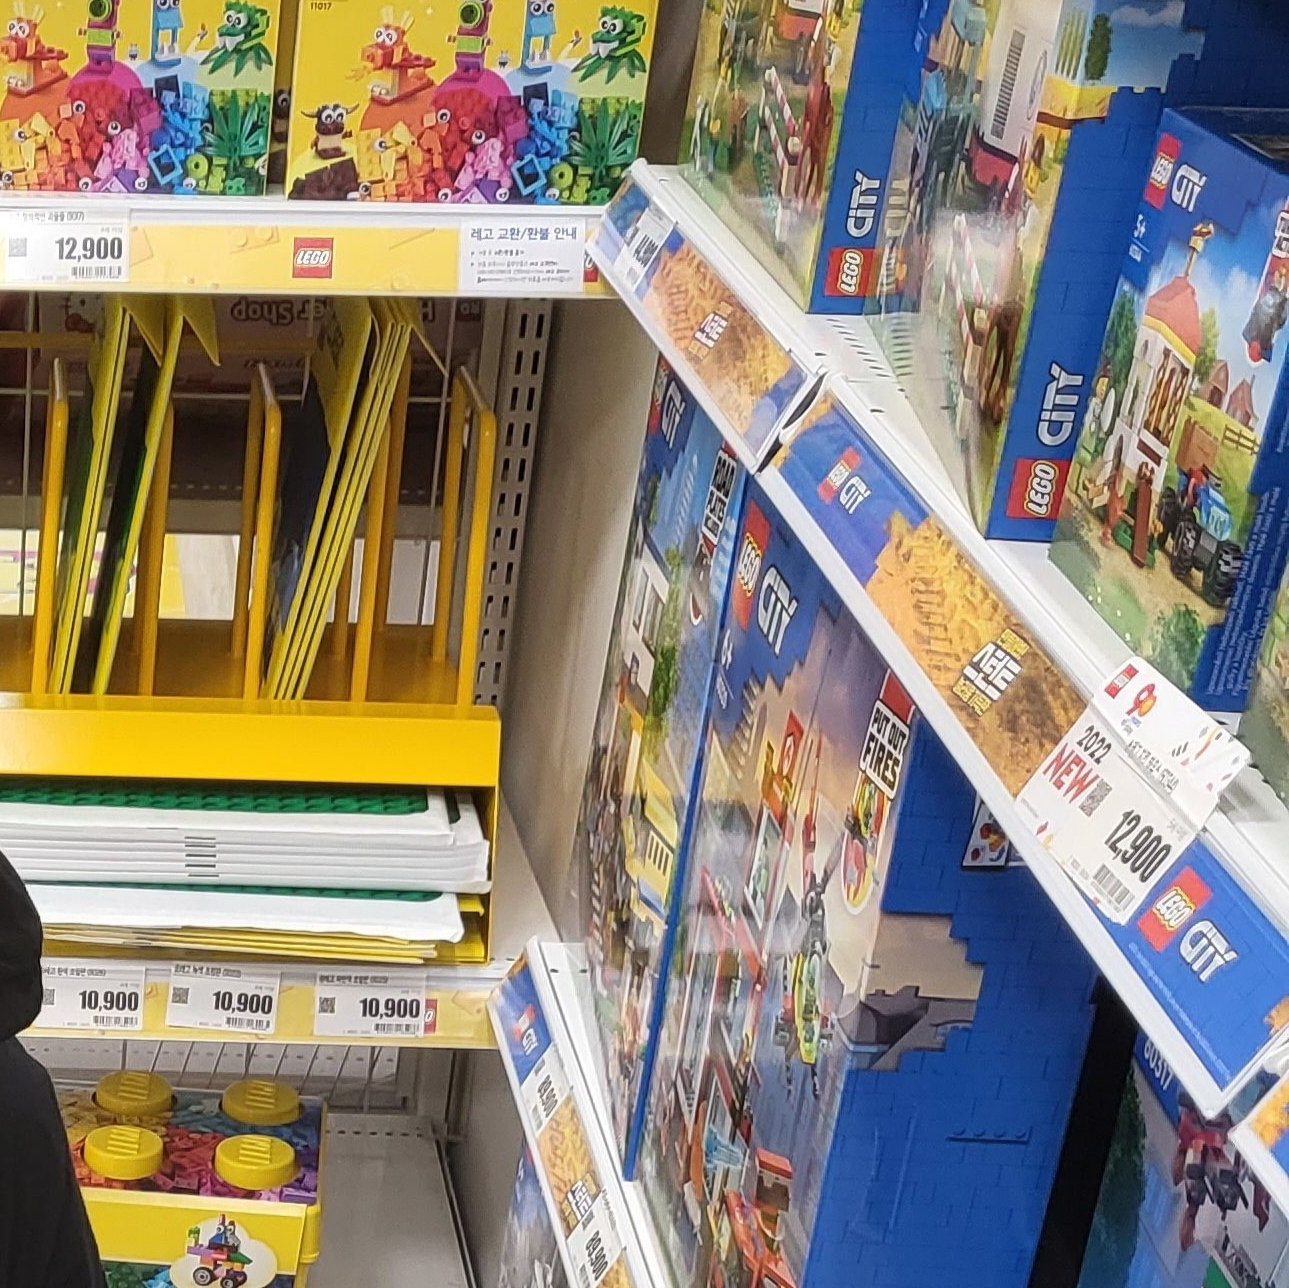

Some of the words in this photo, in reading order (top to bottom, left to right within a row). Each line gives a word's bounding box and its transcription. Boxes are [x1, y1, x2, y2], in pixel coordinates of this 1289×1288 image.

[1151, 153, 1174, 188] LEGO
[1172, 163, 1208, 213] CITY
[846, 169, 880, 238] CITY
[54, 236, 123, 263] 12,900
[295, 247, 334, 270] LEGO
[470, 227, 495, 241] 레고
[497, 227, 550, 241] 교환/환불
[553, 227, 578, 241] 안내
[839, 250, 863, 294] LEGO
[661, 379, 686, 450] CITY
[1036, 361, 1084, 447] CITY
[825, 462, 853, 491] LEGO
[838, 476, 873, 515] CITY
[1027, 462, 1057, 515] LEGO
[736, 530, 763, 597] LEGO
[758, 564, 799, 657] CITY
[871, 706, 891, 739] PUT
[887, 721, 908, 756] OUT
[1075, 724, 1113, 765] 2022
[862, 731, 901, 792] FIRES
[1042, 741, 1100, 805] NEW
[1103, 808, 1172, 884] 12,900
[1152, 884, 1198, 933] LEGO
[1178, 919, 1240, 984] CITY
[78, 989, 140, 1015] 10,900
[212, 990, 273, 1017] 10,900
[358, 997, 421, 1021] 10,900
